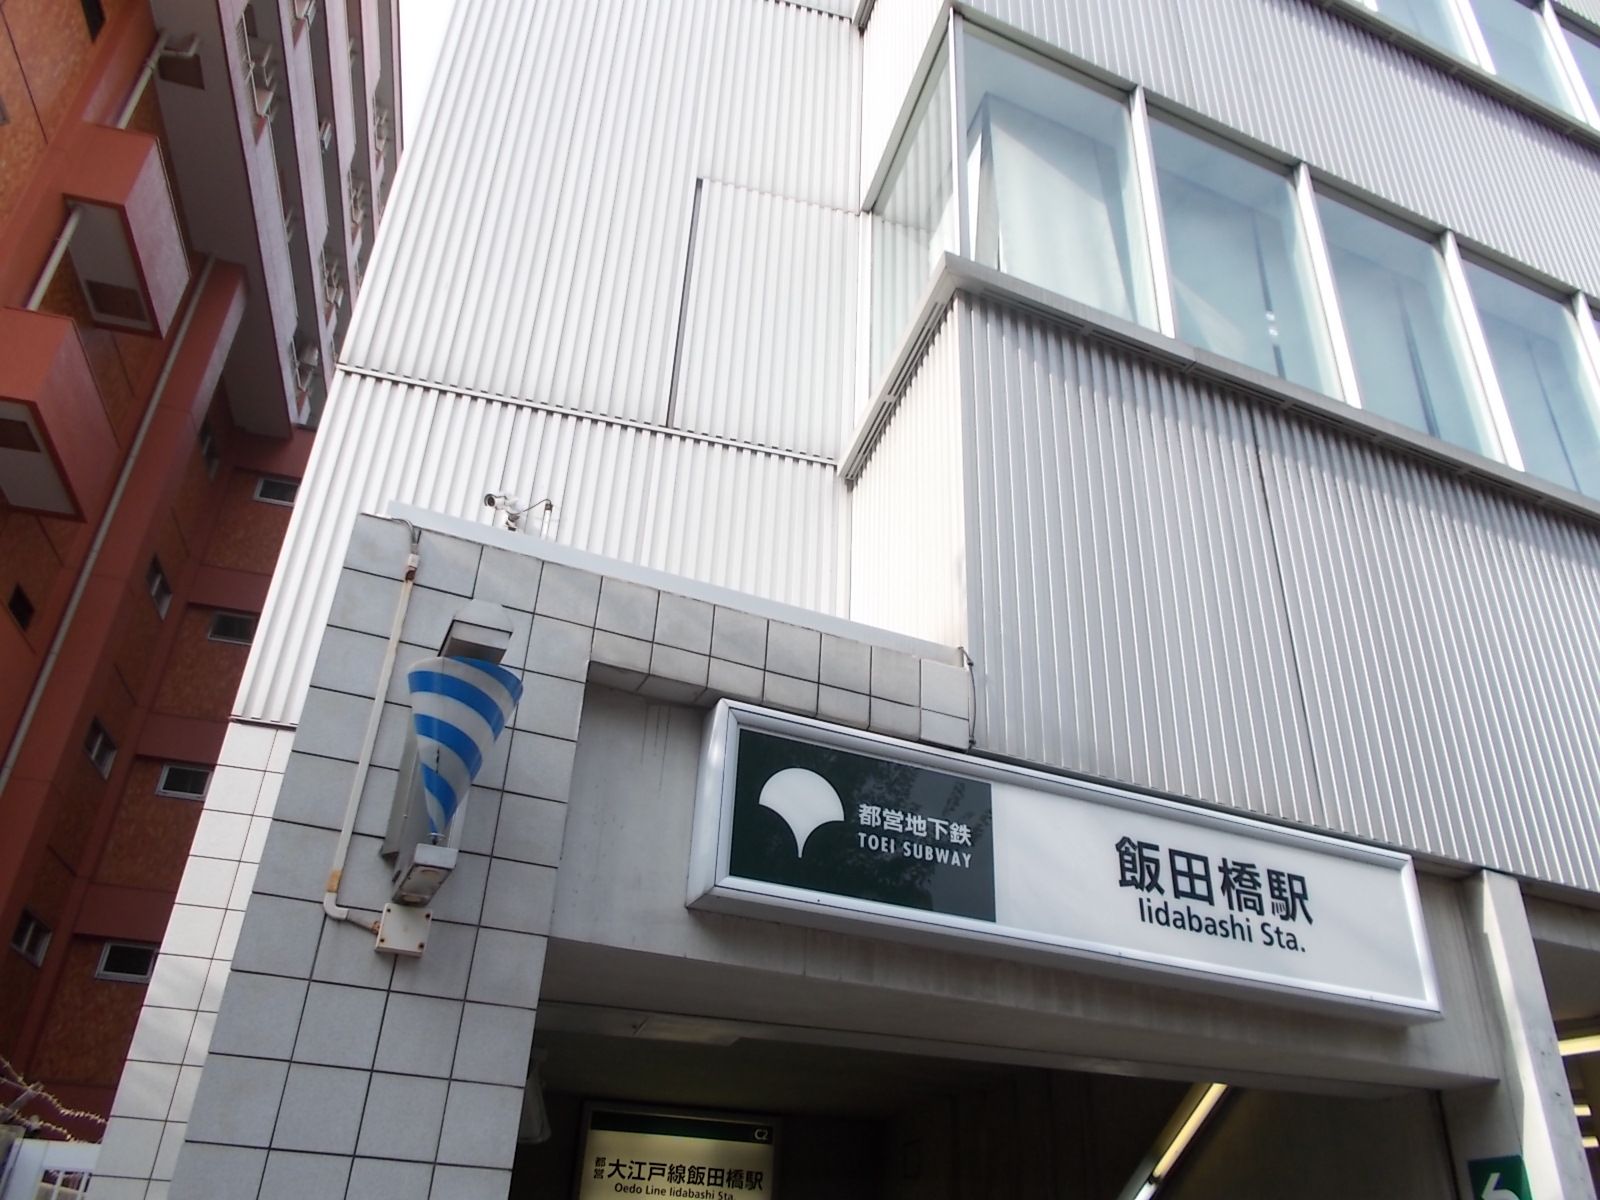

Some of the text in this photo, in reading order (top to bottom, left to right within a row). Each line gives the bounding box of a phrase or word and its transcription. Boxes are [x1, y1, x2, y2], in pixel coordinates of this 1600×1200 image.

[858, 803, 972, 846] 都営地下鉄
[858, 832, 972, 868] TOEI SUBWAY
[1115, 836, 1313, 925] 飯田橋駅
[1139, 897, 1306, 953] Iidabashi Sta.
[754, 1128, 769, 1141] C2
[593, 1157, 606, 1179] 都営
[607, 1159, 764, 1191] 大江戸線飯田橋駅
[614, 1182, 643, 1194] Oedo
[645, 1185, 667, 1197] Line
[669, 1186, 715, 1199] Iidabashi
